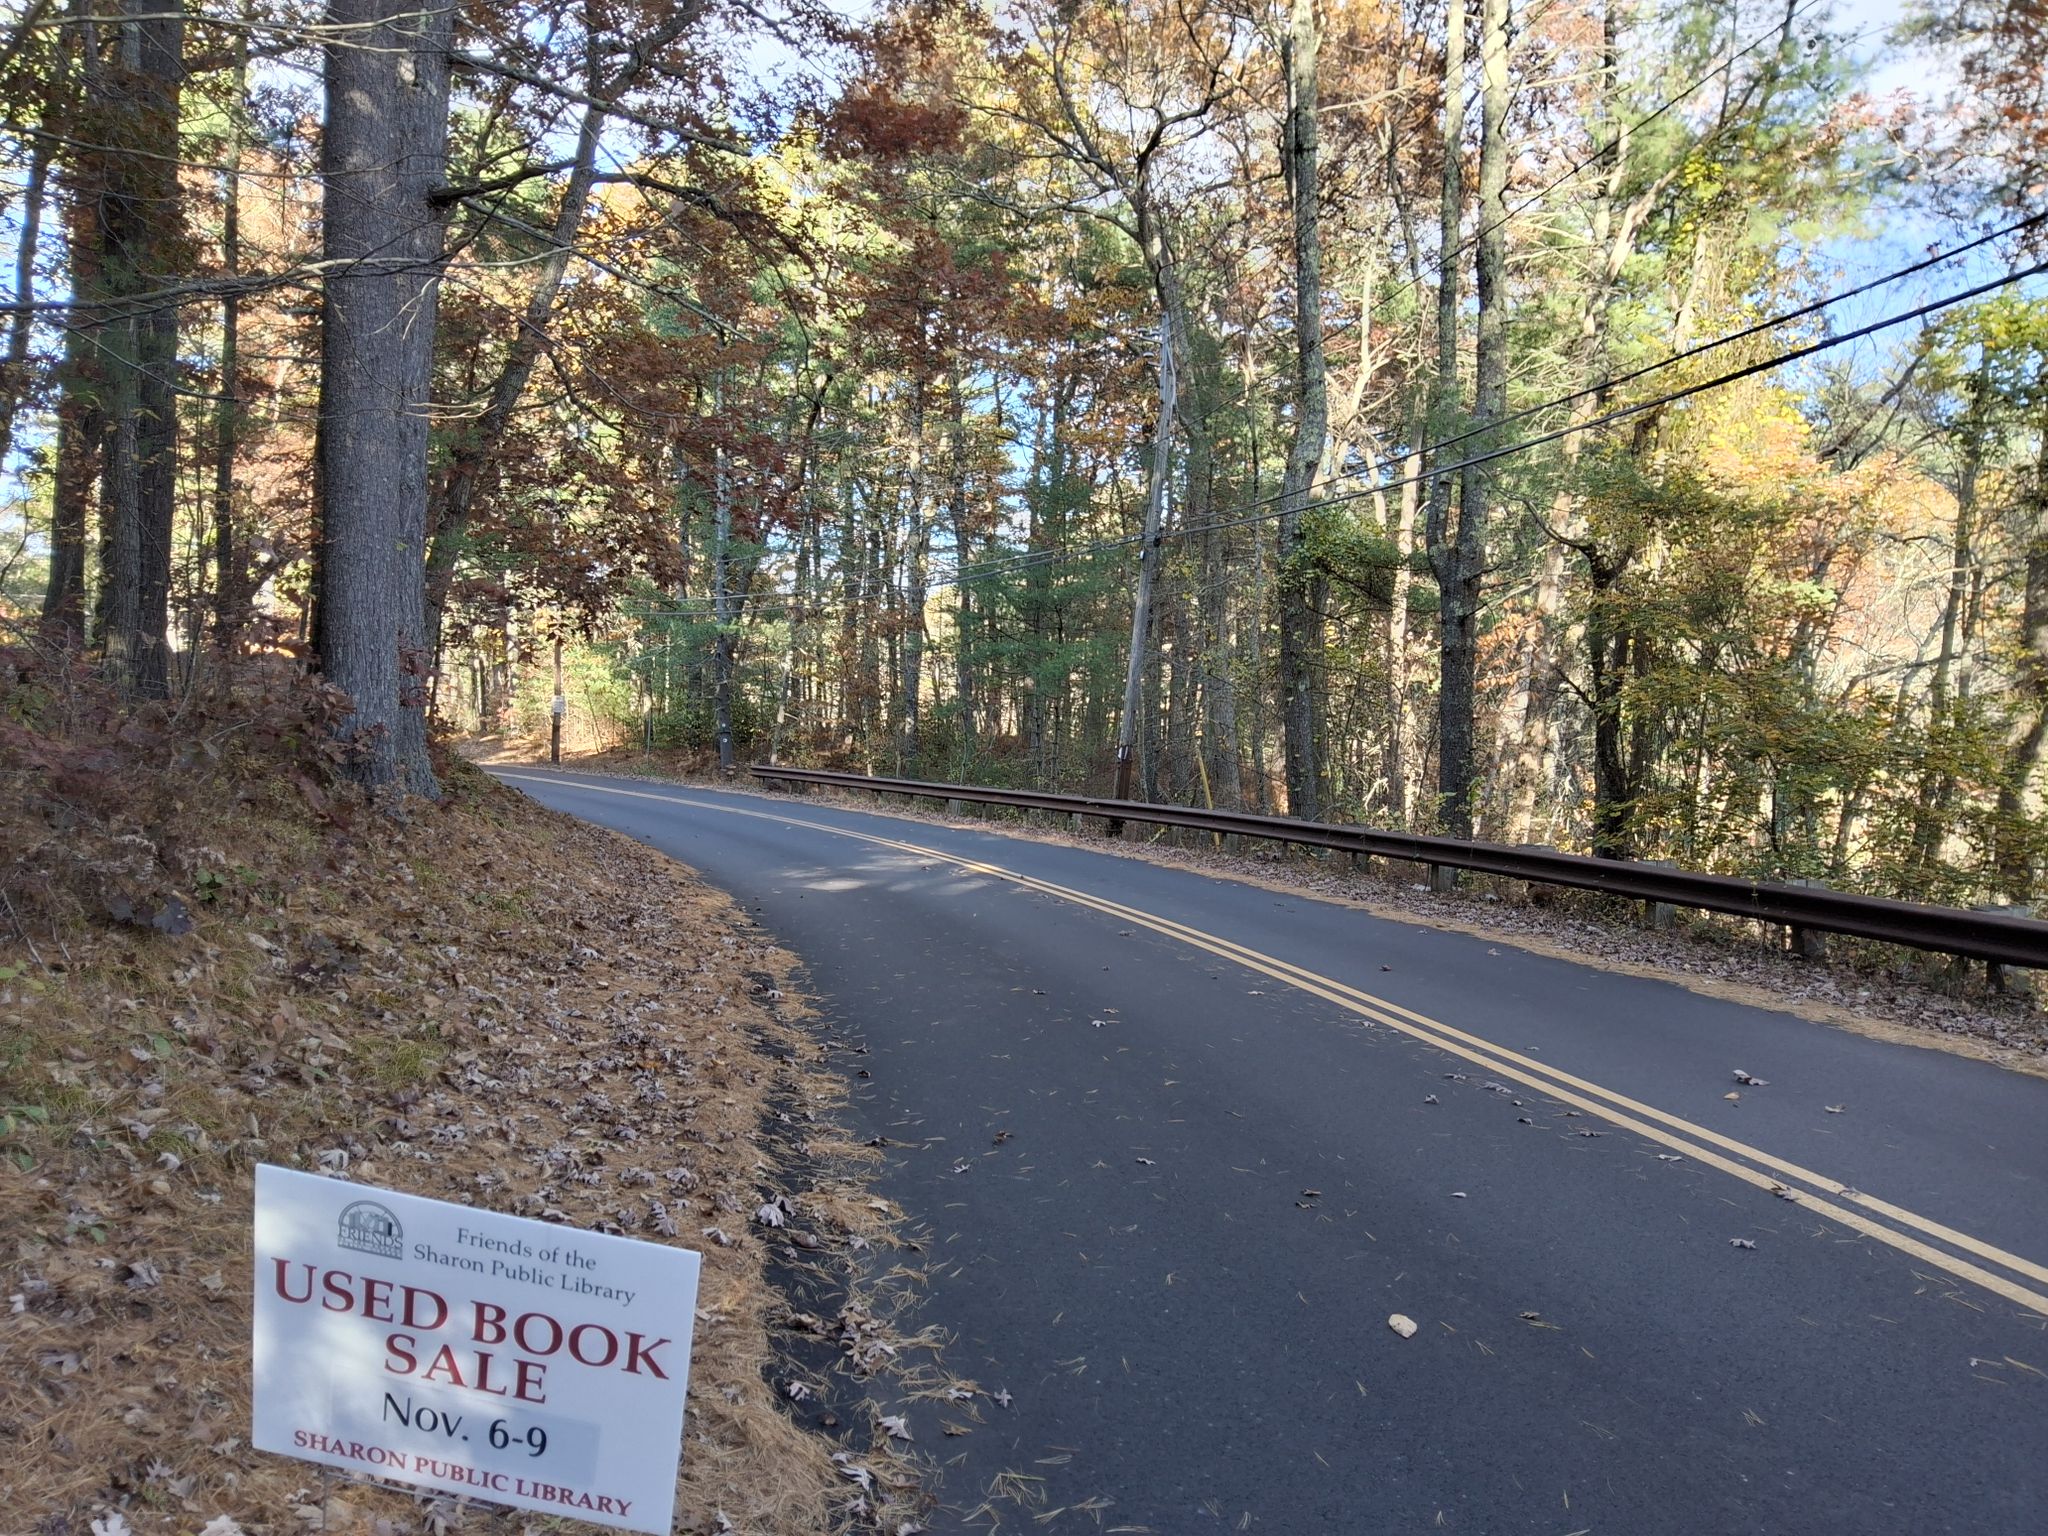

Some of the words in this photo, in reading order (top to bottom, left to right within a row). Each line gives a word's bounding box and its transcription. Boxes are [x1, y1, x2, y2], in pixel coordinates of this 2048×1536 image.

[414, 1244, 484, 1273] Sharon
[492, 1260, 553, 1287] Public
[561, 1274, 636, 1307] Library
[457, 1228, 532, 1257] Friends
[539, 1247, 560, 1263] of
[566, 1250, 596, 1271] the
[271, 1257, 448, 1331] USED
[470, 1300, 672, 1380] BOOK
[384, 1333, 546, 1404] SALE
[488, 1419, 547, 1457] 6-9
[294, 1430, 406, 1469] SHARON
[414, 1456, 509, 1492] PUBLIC
[515, 1479, 632, 1517] LIBRARY
